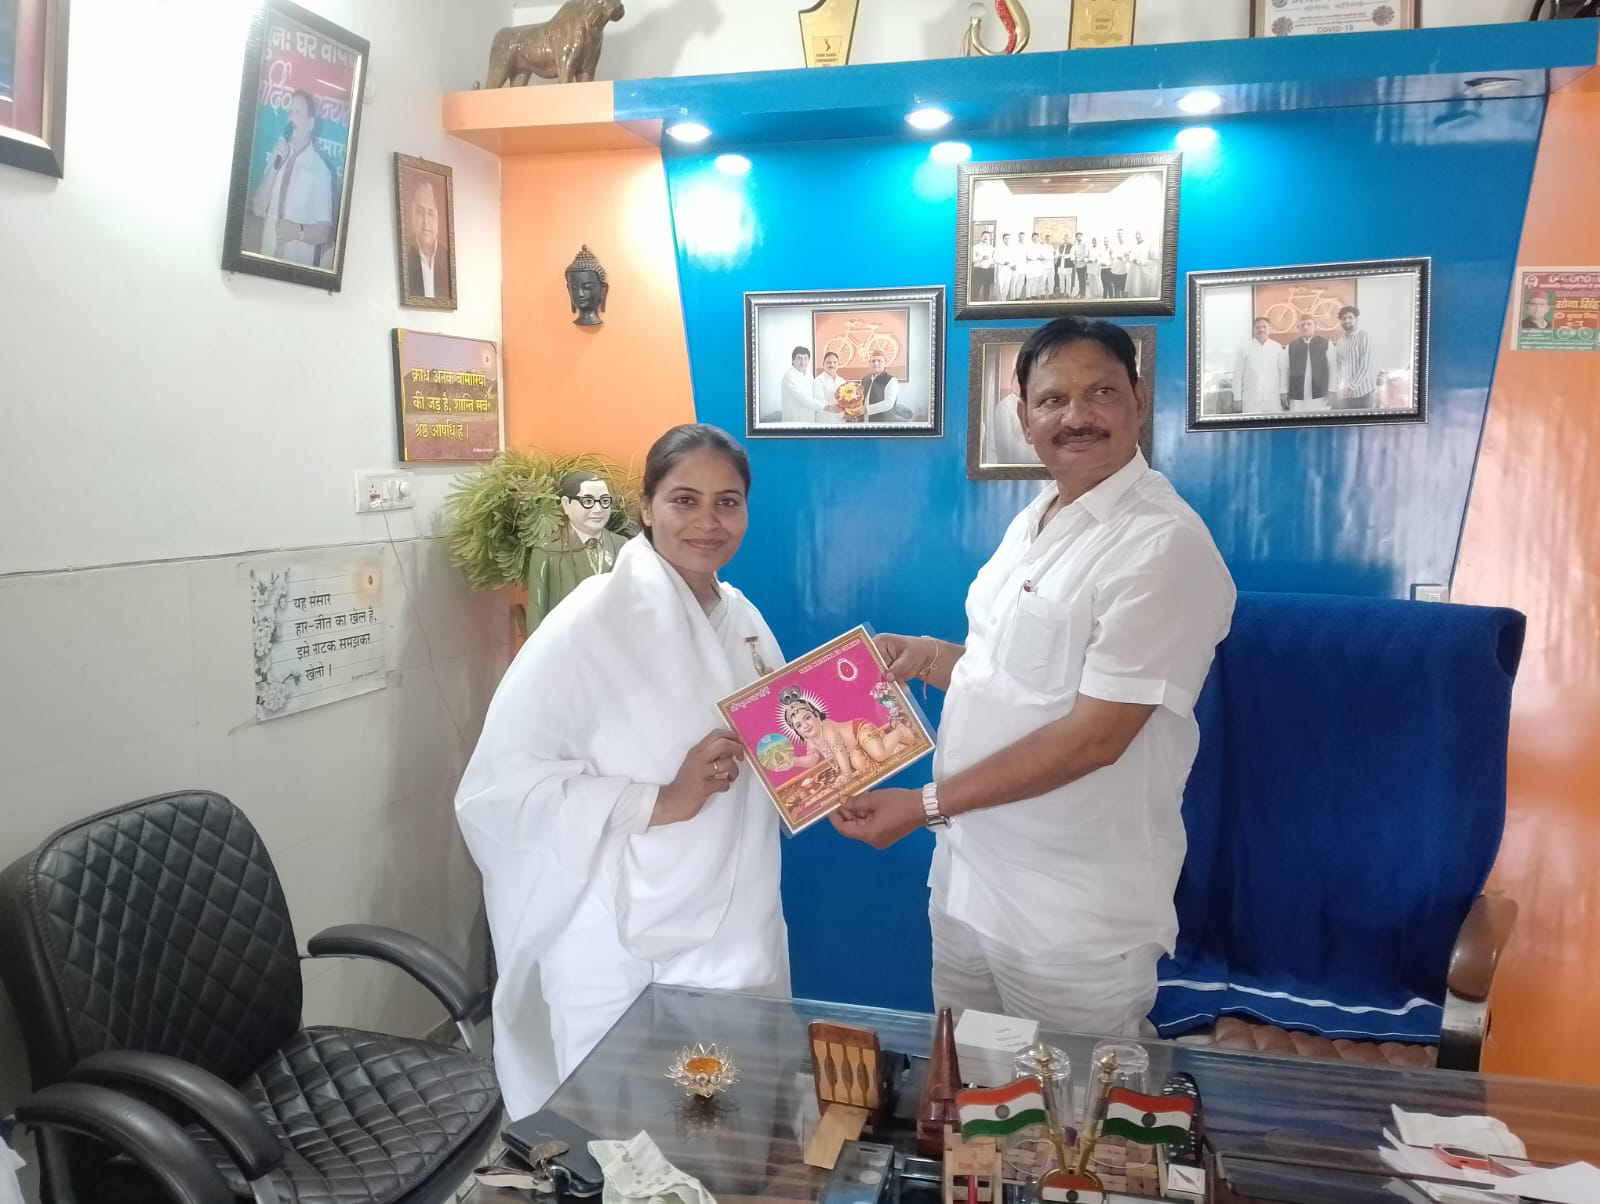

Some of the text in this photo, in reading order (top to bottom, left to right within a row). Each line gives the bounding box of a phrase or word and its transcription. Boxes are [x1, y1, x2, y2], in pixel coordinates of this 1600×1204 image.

[1316, 25, 1354, 34] COVID-19
[296, 31, 319, 60] घर
[412, 391, 425, 409] की
[453, 393, 474, 411] शान्ति
[293, 590, 331, 611] यह संसार
[294, 605, 377, 636] हार-जीत का खेल है,
[296, 633, 371, 660] इसे नाटक समझकर
[305, 661, 324, 681] खेलो
